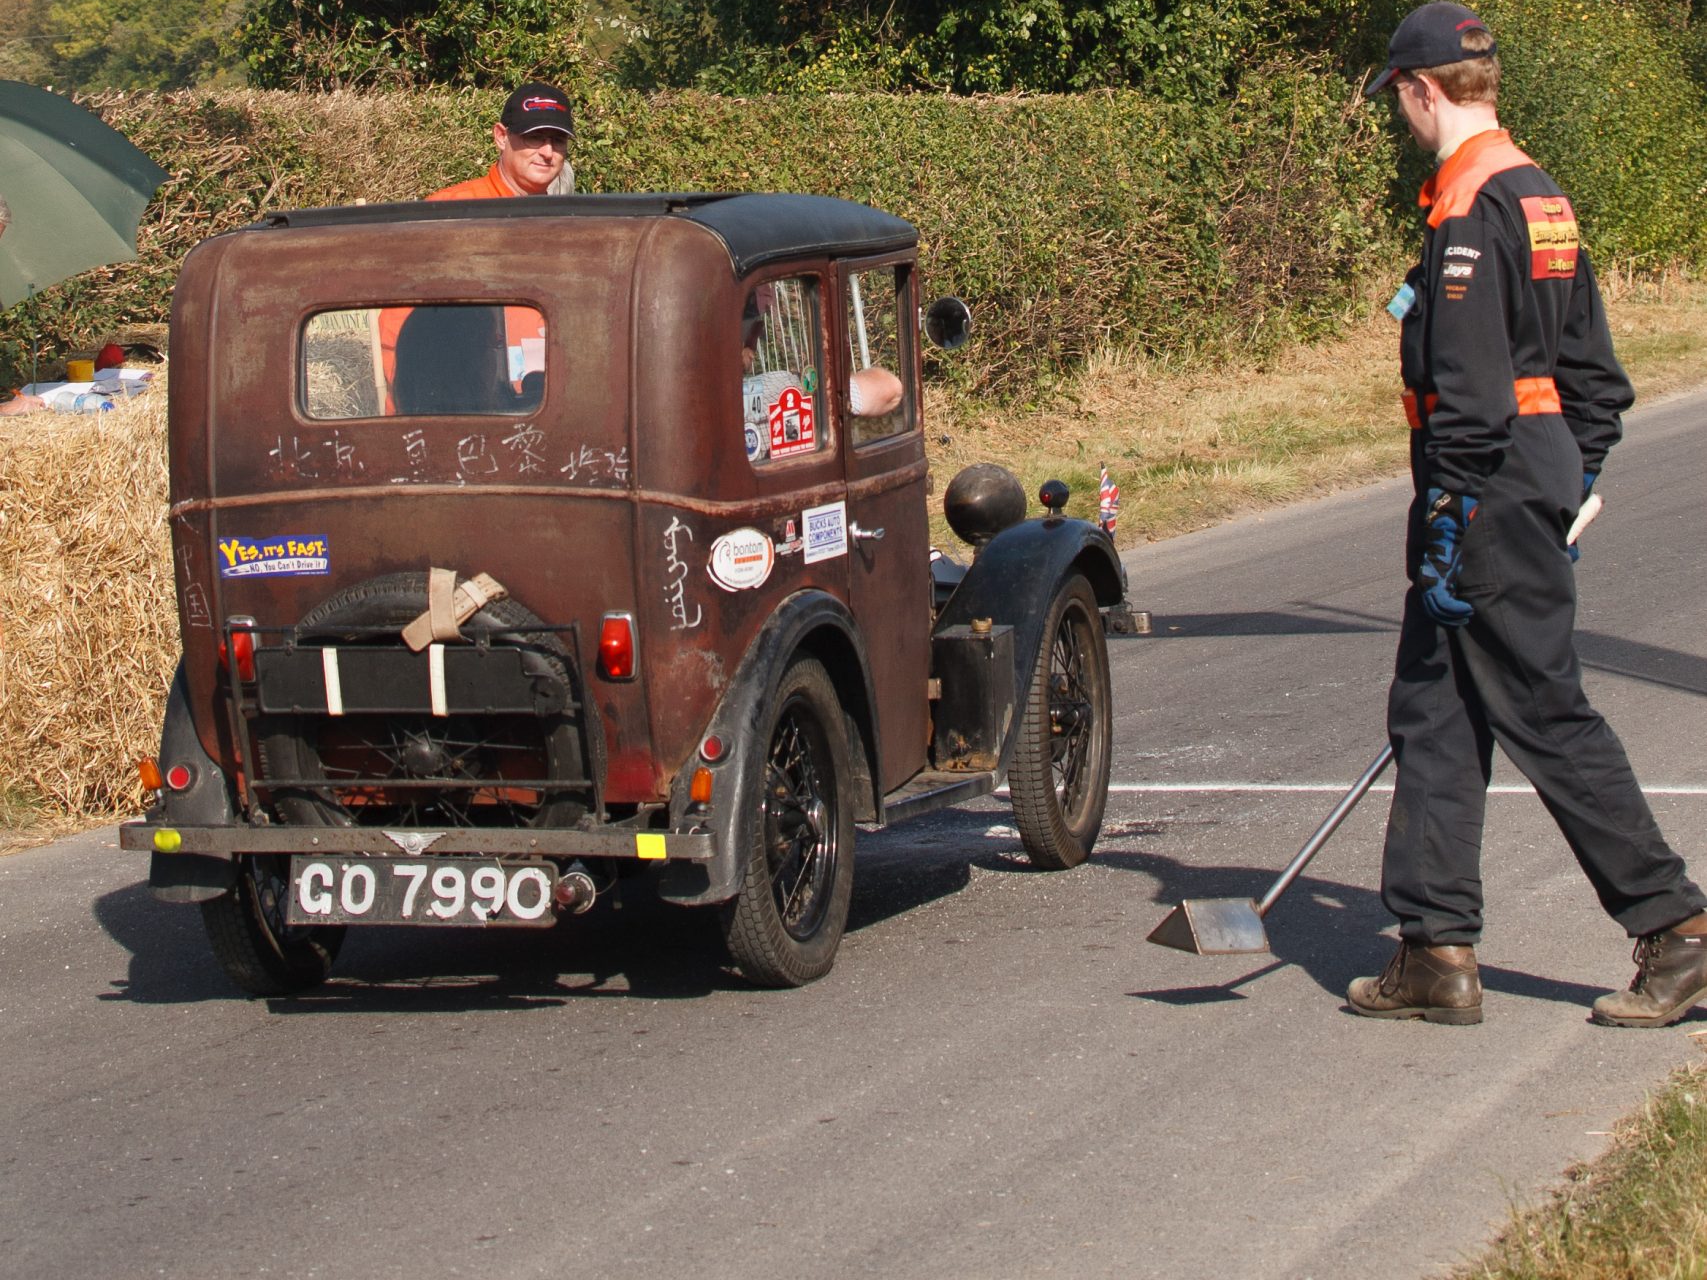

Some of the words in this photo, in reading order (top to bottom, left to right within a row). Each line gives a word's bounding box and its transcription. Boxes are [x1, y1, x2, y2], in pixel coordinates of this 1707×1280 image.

[1444, 246, 1482, 260] CIDENT
[786, 393, 795, 408] 2
[264, 562, 276, 571] You
[277, 561, 295, 570] Can't
[297, 559, 314, 569] Drive
[299, 863, 375, 916] GO
[393, 864, 551, 923] 7990
